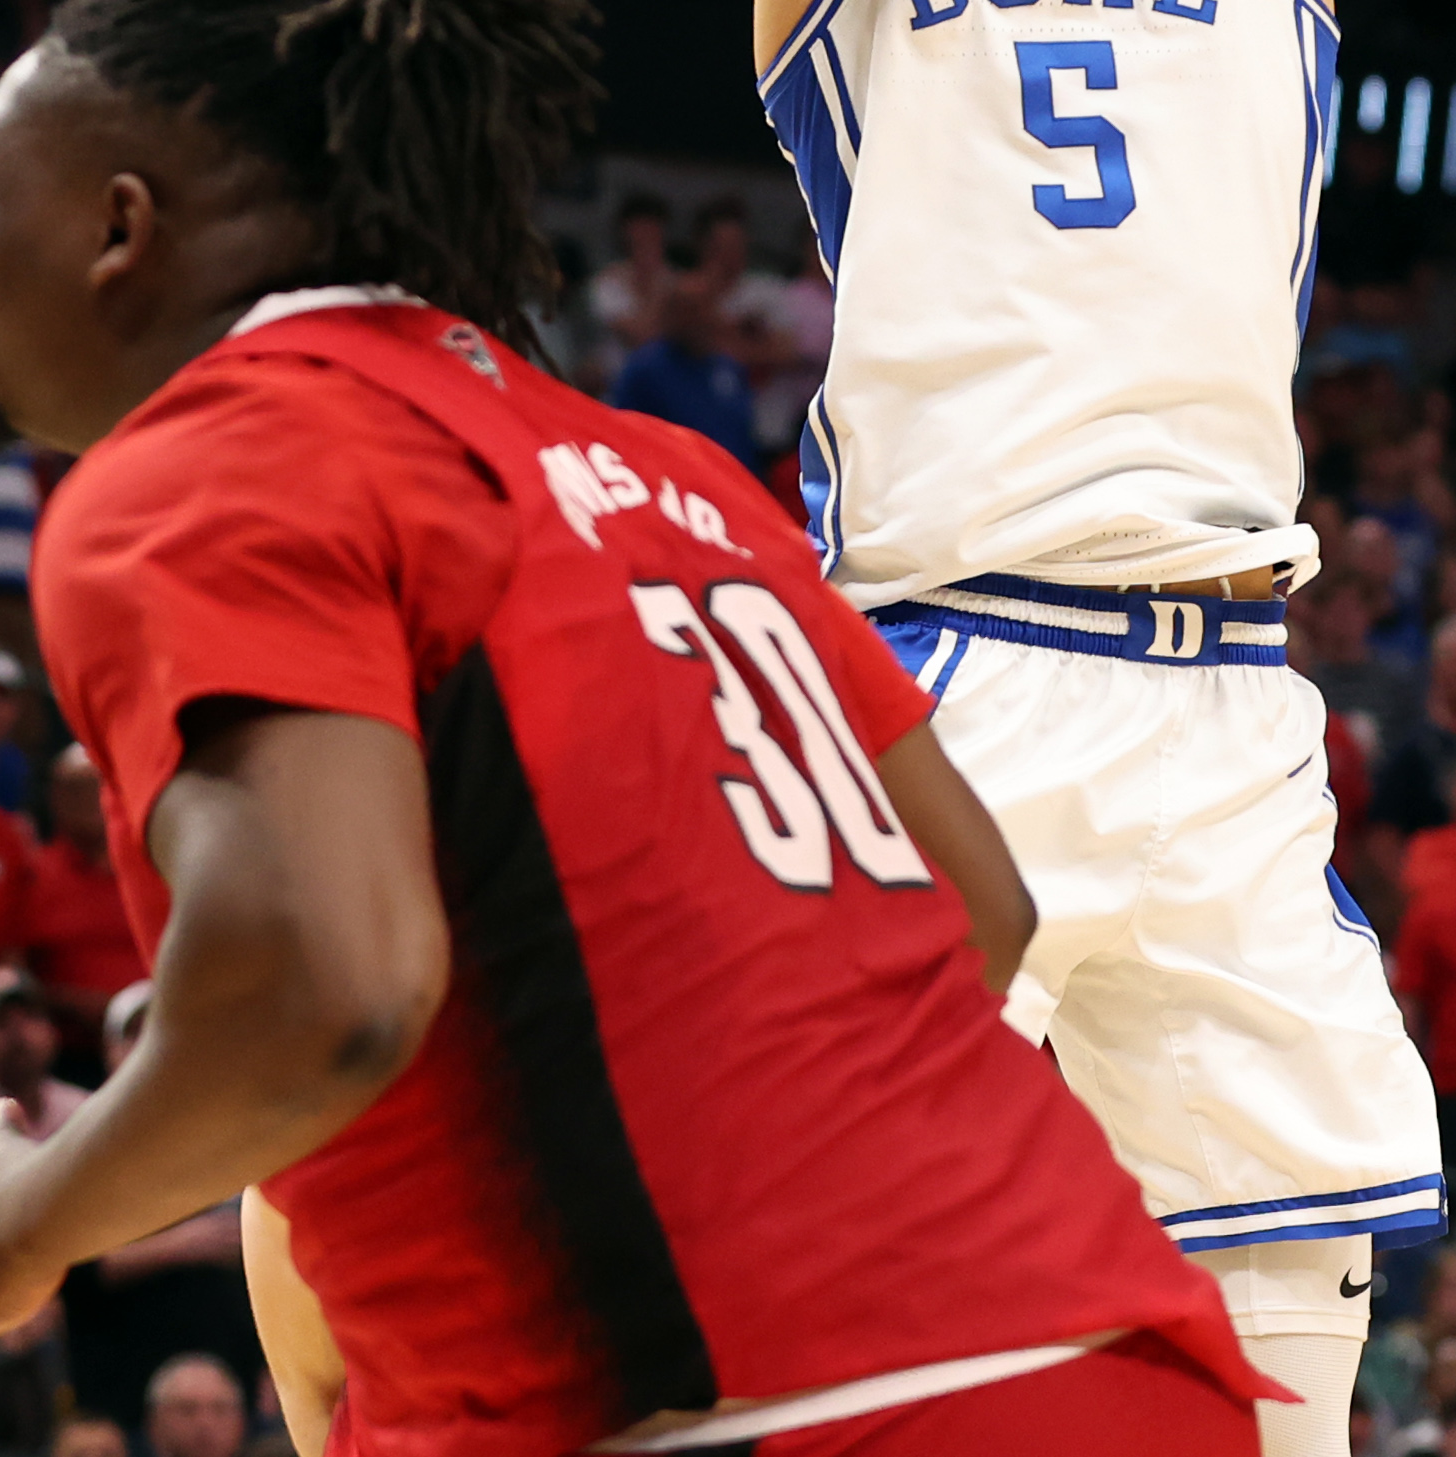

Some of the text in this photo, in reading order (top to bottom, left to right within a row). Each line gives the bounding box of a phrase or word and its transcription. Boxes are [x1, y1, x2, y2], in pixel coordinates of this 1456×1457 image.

[1013, 40, 1136, 229] 5
[1145, 599, 1205, 660] D
[628, 578, 936, 894] 30
